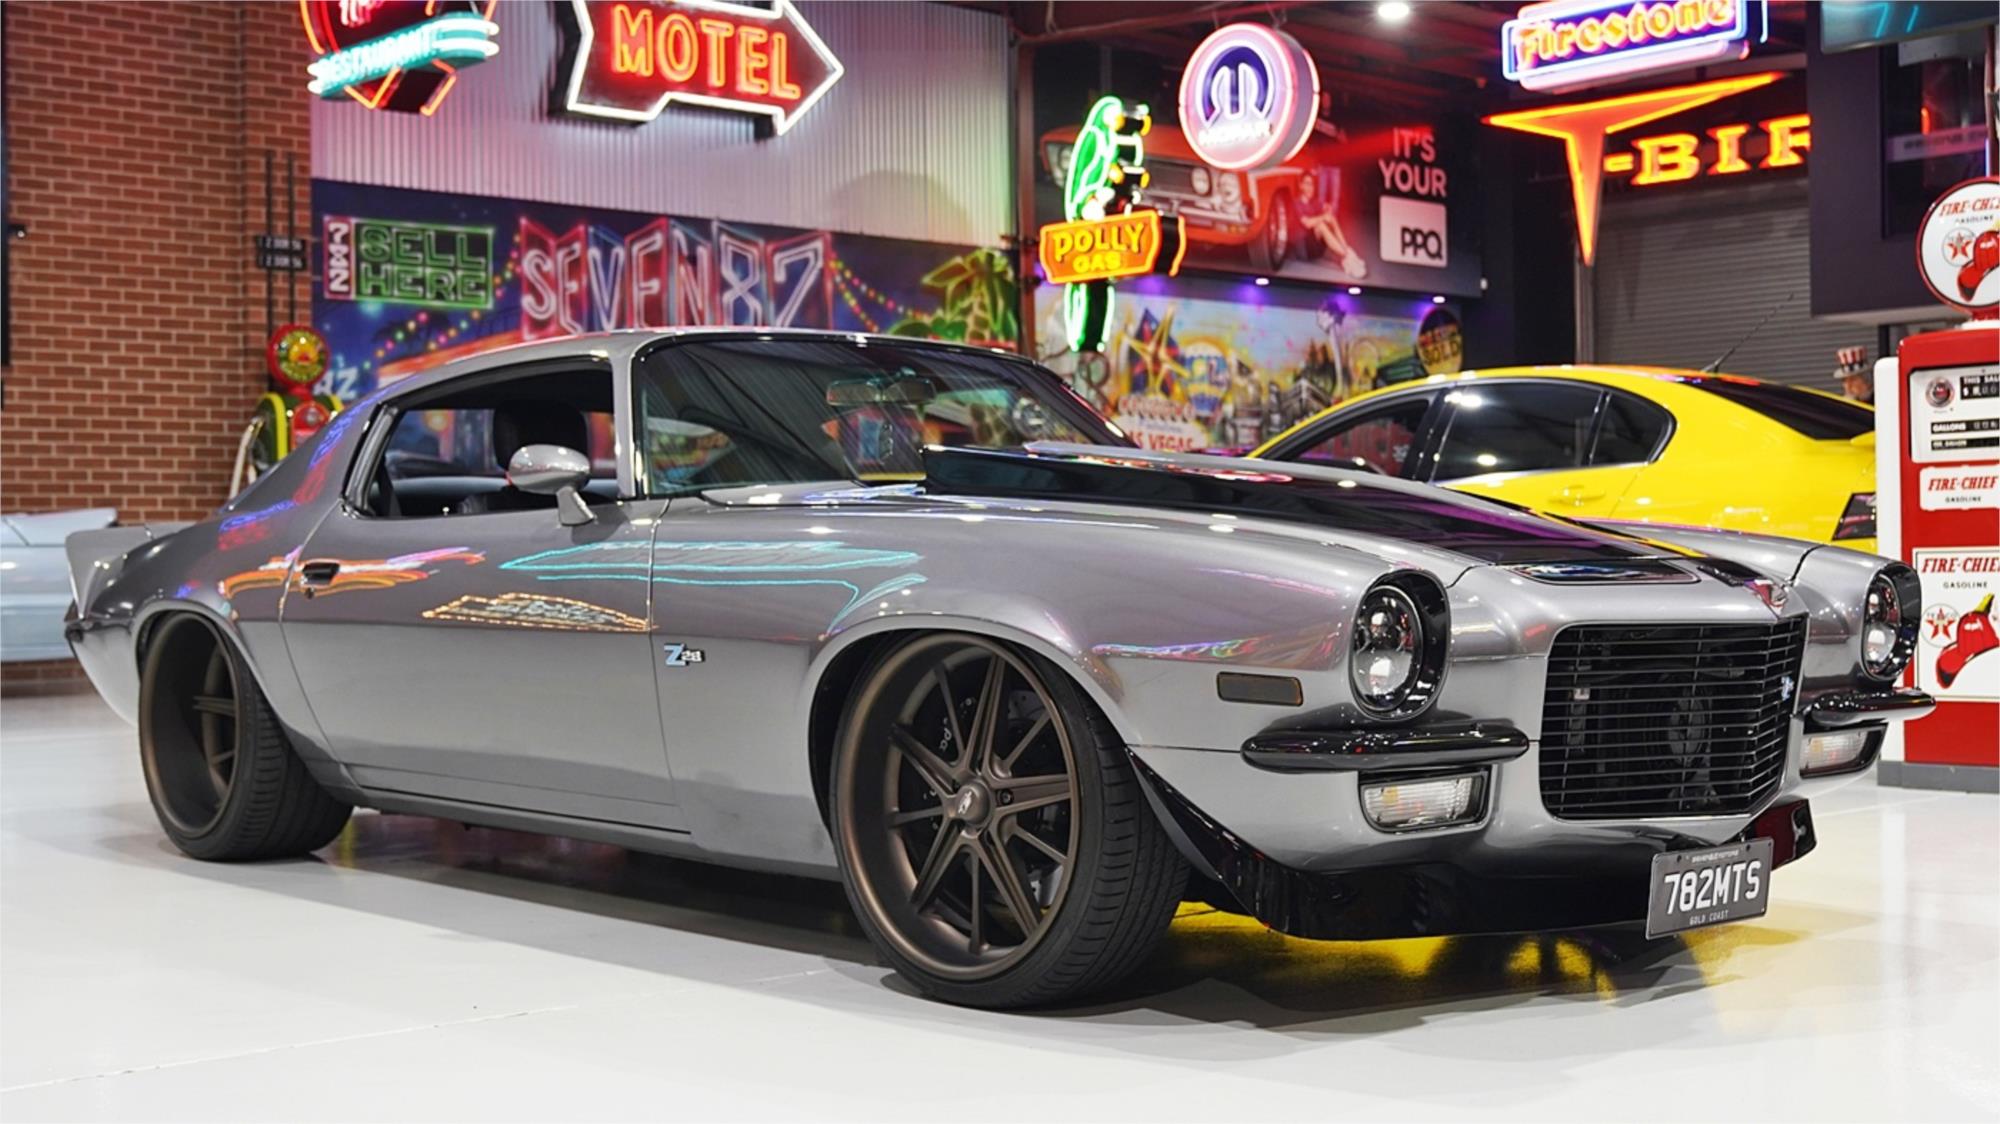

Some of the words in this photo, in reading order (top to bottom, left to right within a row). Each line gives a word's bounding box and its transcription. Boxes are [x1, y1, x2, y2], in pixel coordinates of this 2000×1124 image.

[613, 4, 801, 99] MOTEL
[1516, 1, 1735, 69] Firestone
[1393, 127, 1436, 162] IT'S
[1378, 158, 1447, 198] YOUR
[360, 226, 487, 268] SELL
[1053, 222, 1145, 262] POLLY
[1401, 226, 1443, 260] PPQ
[1073, 251, 1121, 273] GAS
[360, 263, 488, 304] HERE
[1148, 433, 1194, 450] VEGAS
[1922, 557, 1999, 573] FIRE-CHIE
[1943, 581, 1988, 589] GASOLINE
[663, 643, 705, 666] Z28
[1664, 860, 1761, 915] 782MTS
[1709, 909, 1729, 922] COAST
